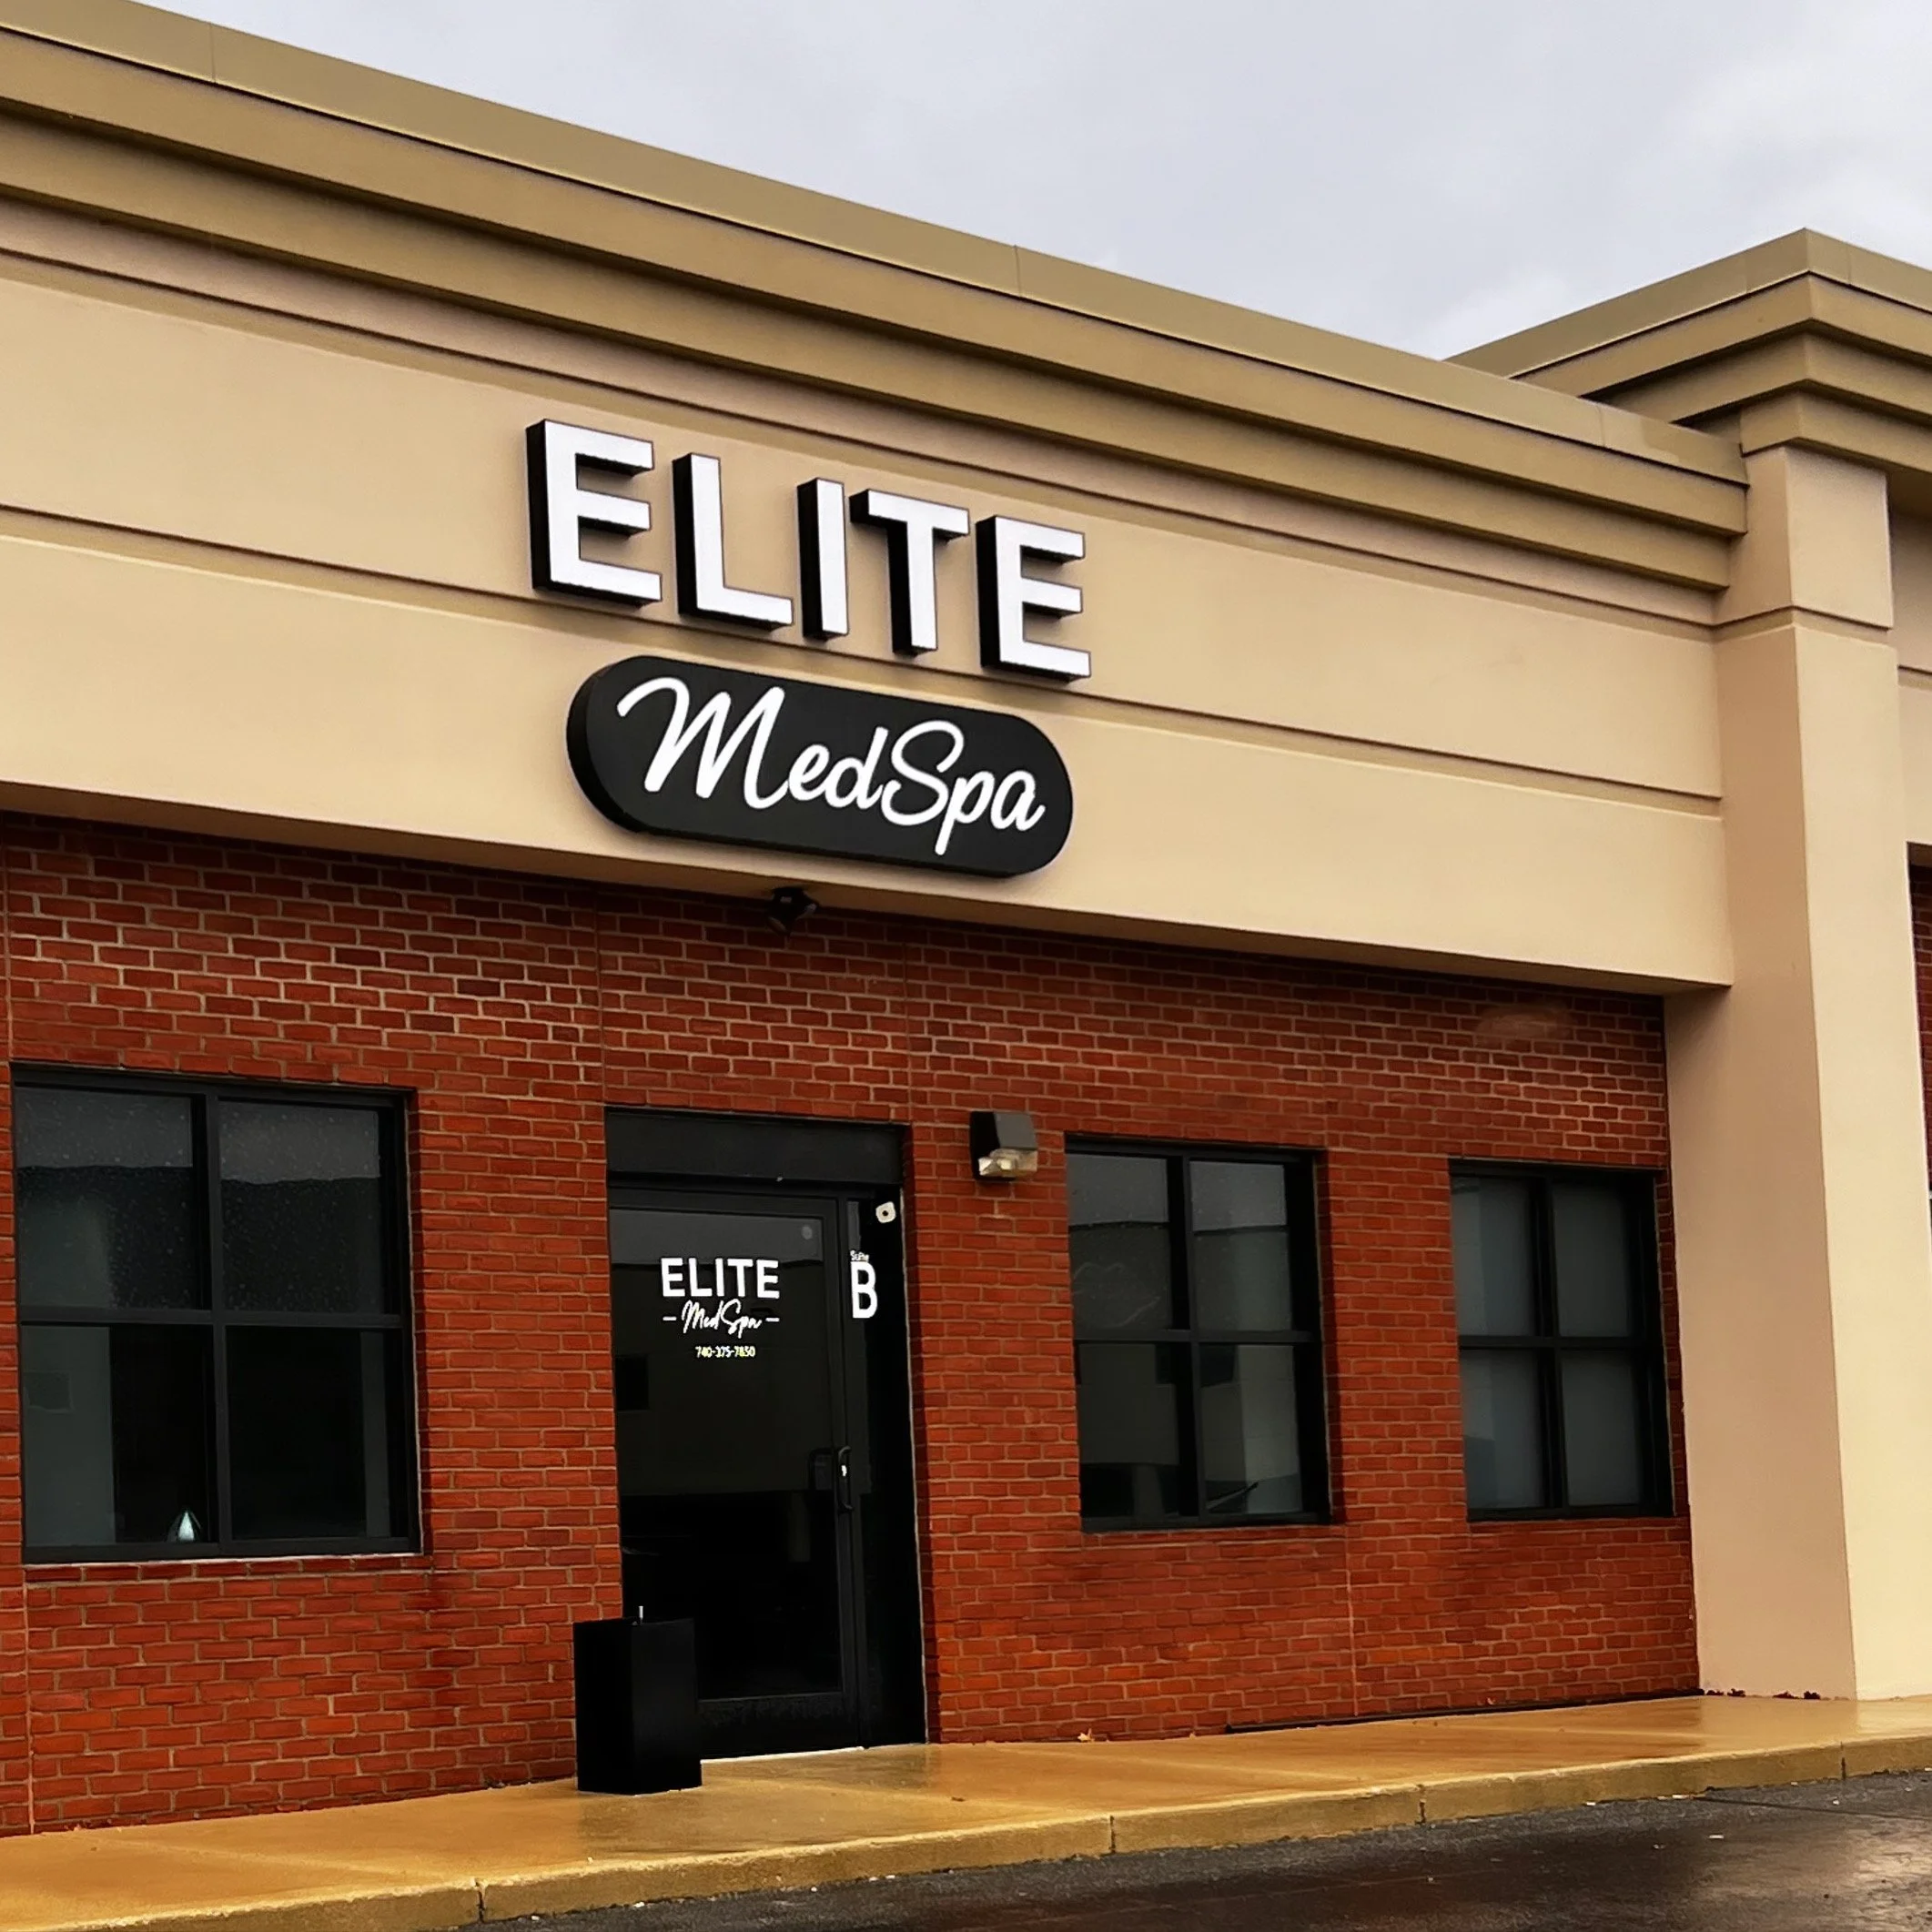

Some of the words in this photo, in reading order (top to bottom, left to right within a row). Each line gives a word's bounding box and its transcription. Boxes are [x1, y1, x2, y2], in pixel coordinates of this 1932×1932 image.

[526, 420, 1091, 683] ELITE
[617, 677, 1046, 855] MedSpa
[662, 1258, 780, 1300] ELITE
[850, 1261, 878, 1319] B
[681, 1299, 763, 1339] MedSpa
